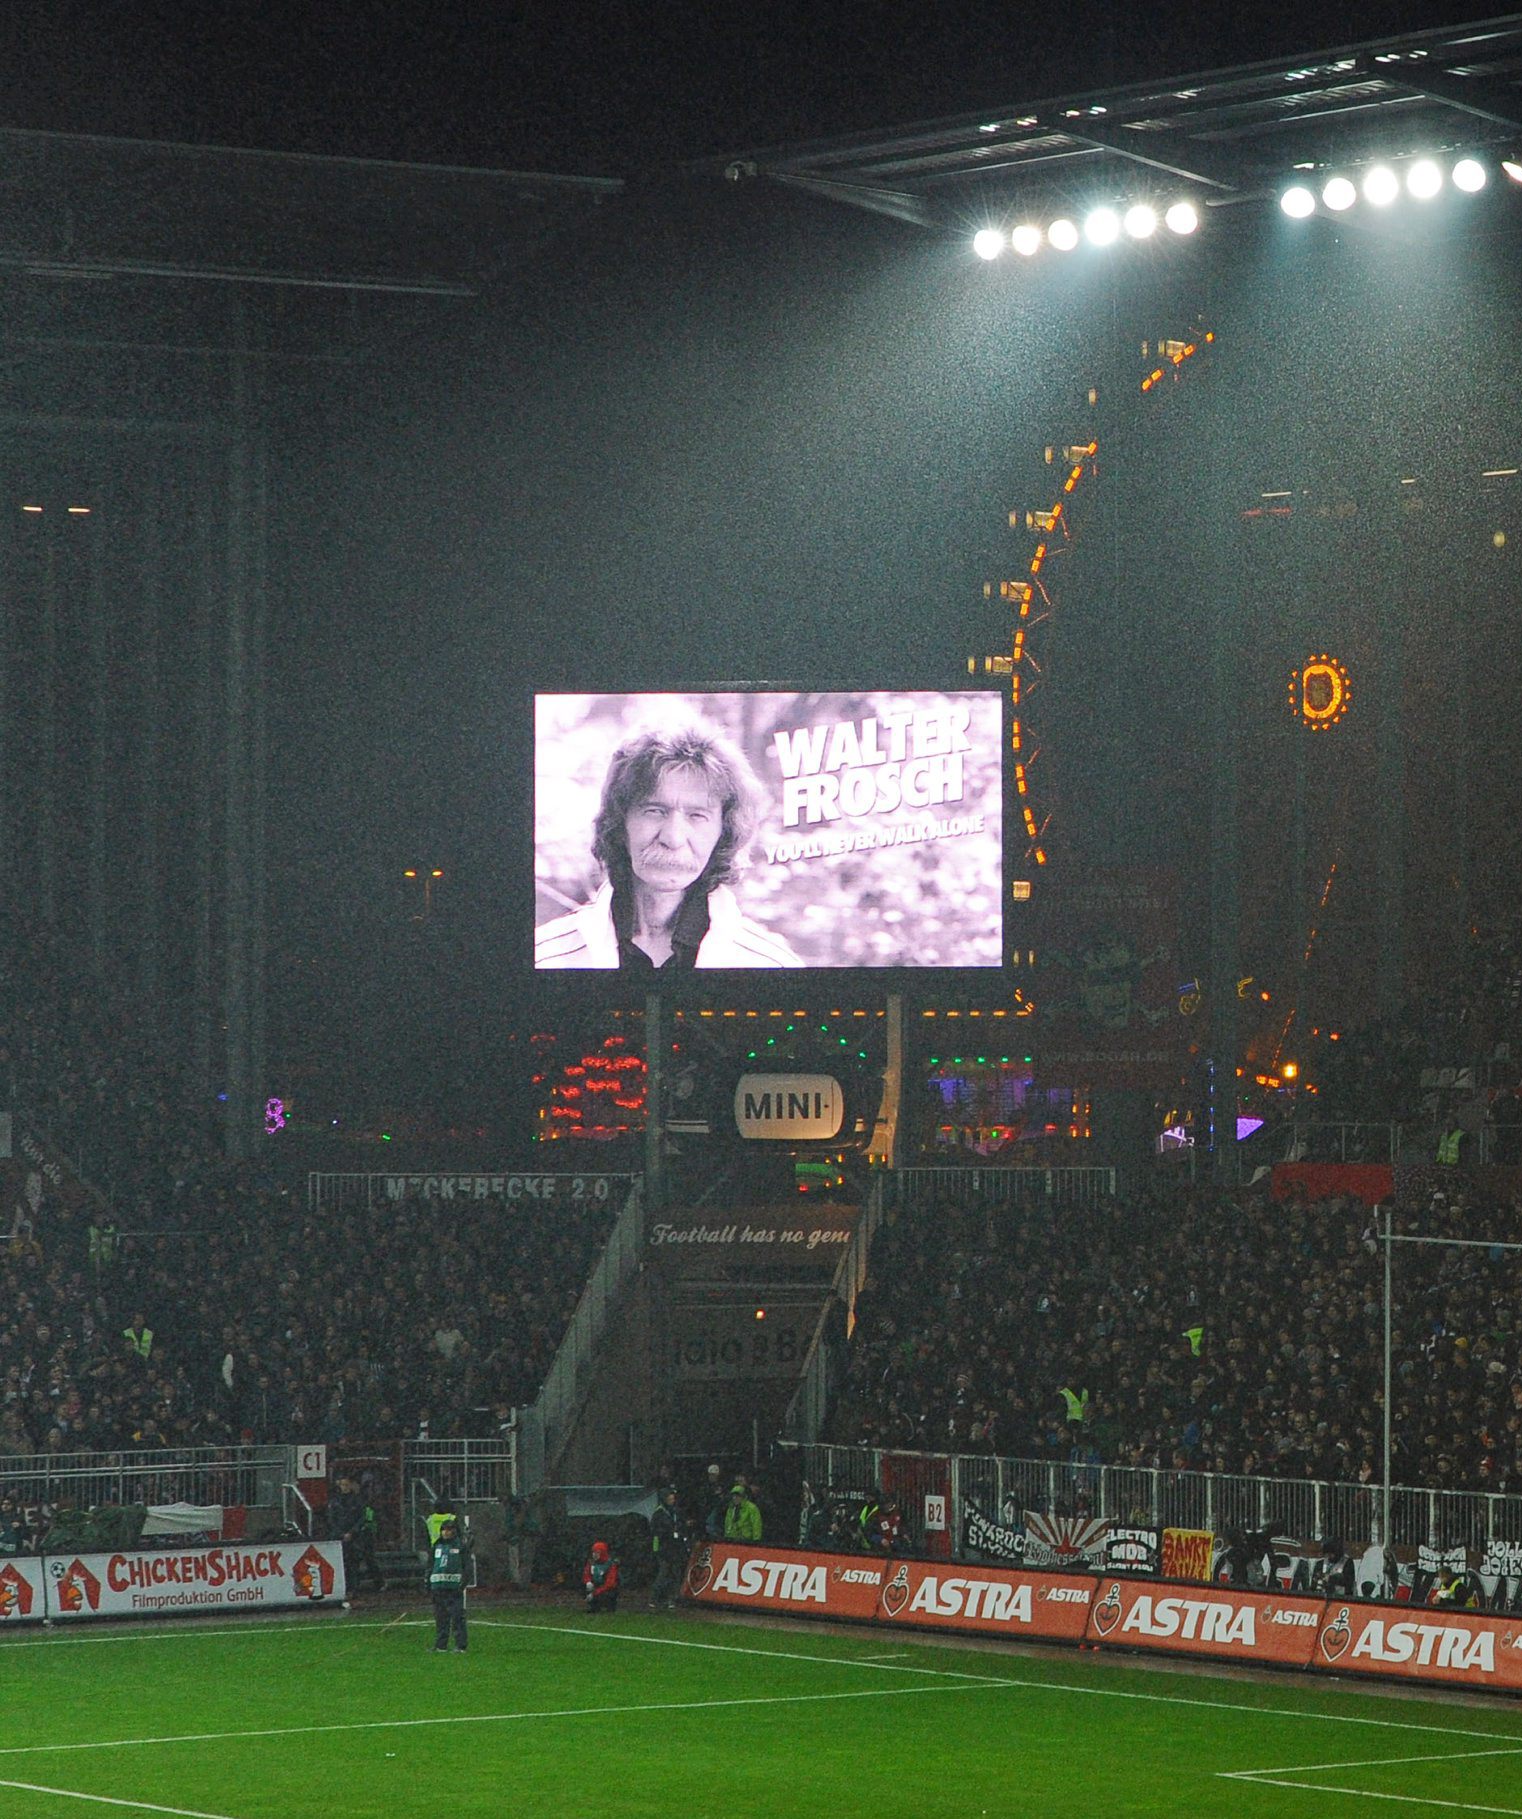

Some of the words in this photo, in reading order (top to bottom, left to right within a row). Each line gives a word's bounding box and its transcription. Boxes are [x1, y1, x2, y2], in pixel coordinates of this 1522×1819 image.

[774, 706, 972, 779] WALTER
[783, 754, 965, 828] FROSCH
[765, 842, 822, 865] YOU'LL
[823, 832, 876, 857] NEVER
[876, 824, 932, 848] WALK
[931, 815, 985, 840] ALONE
[744, 1092, 823, 1121] MINI
[650, 1223, 736, 1246] Football
[739, 1225, 776, 1243] has
[779, 1229, 804, 1243] no
[302, 1451, 321, 1472] C1
[927, 1503, 943, 1523] B2
[1111, 1544, 1149, 1561] MOB
[712, 1557, 828, 1603] ASTRA
[840, 1569, 882, 1585] ASTRA
[132, 1592, 222, 1611] Filmproduktion
[227, 1586, 264, 1604] GmbH
[909, 1578, 1032, 1623] ASTRA
[1041, 1586, 1091, 1605] ASTRA
[1122, 1597, 1257, 1647] ASTRA
[1271, 1609, 1319, 1628] ASTRA
[1351, 1619, 1496, 1673] ASTRA
